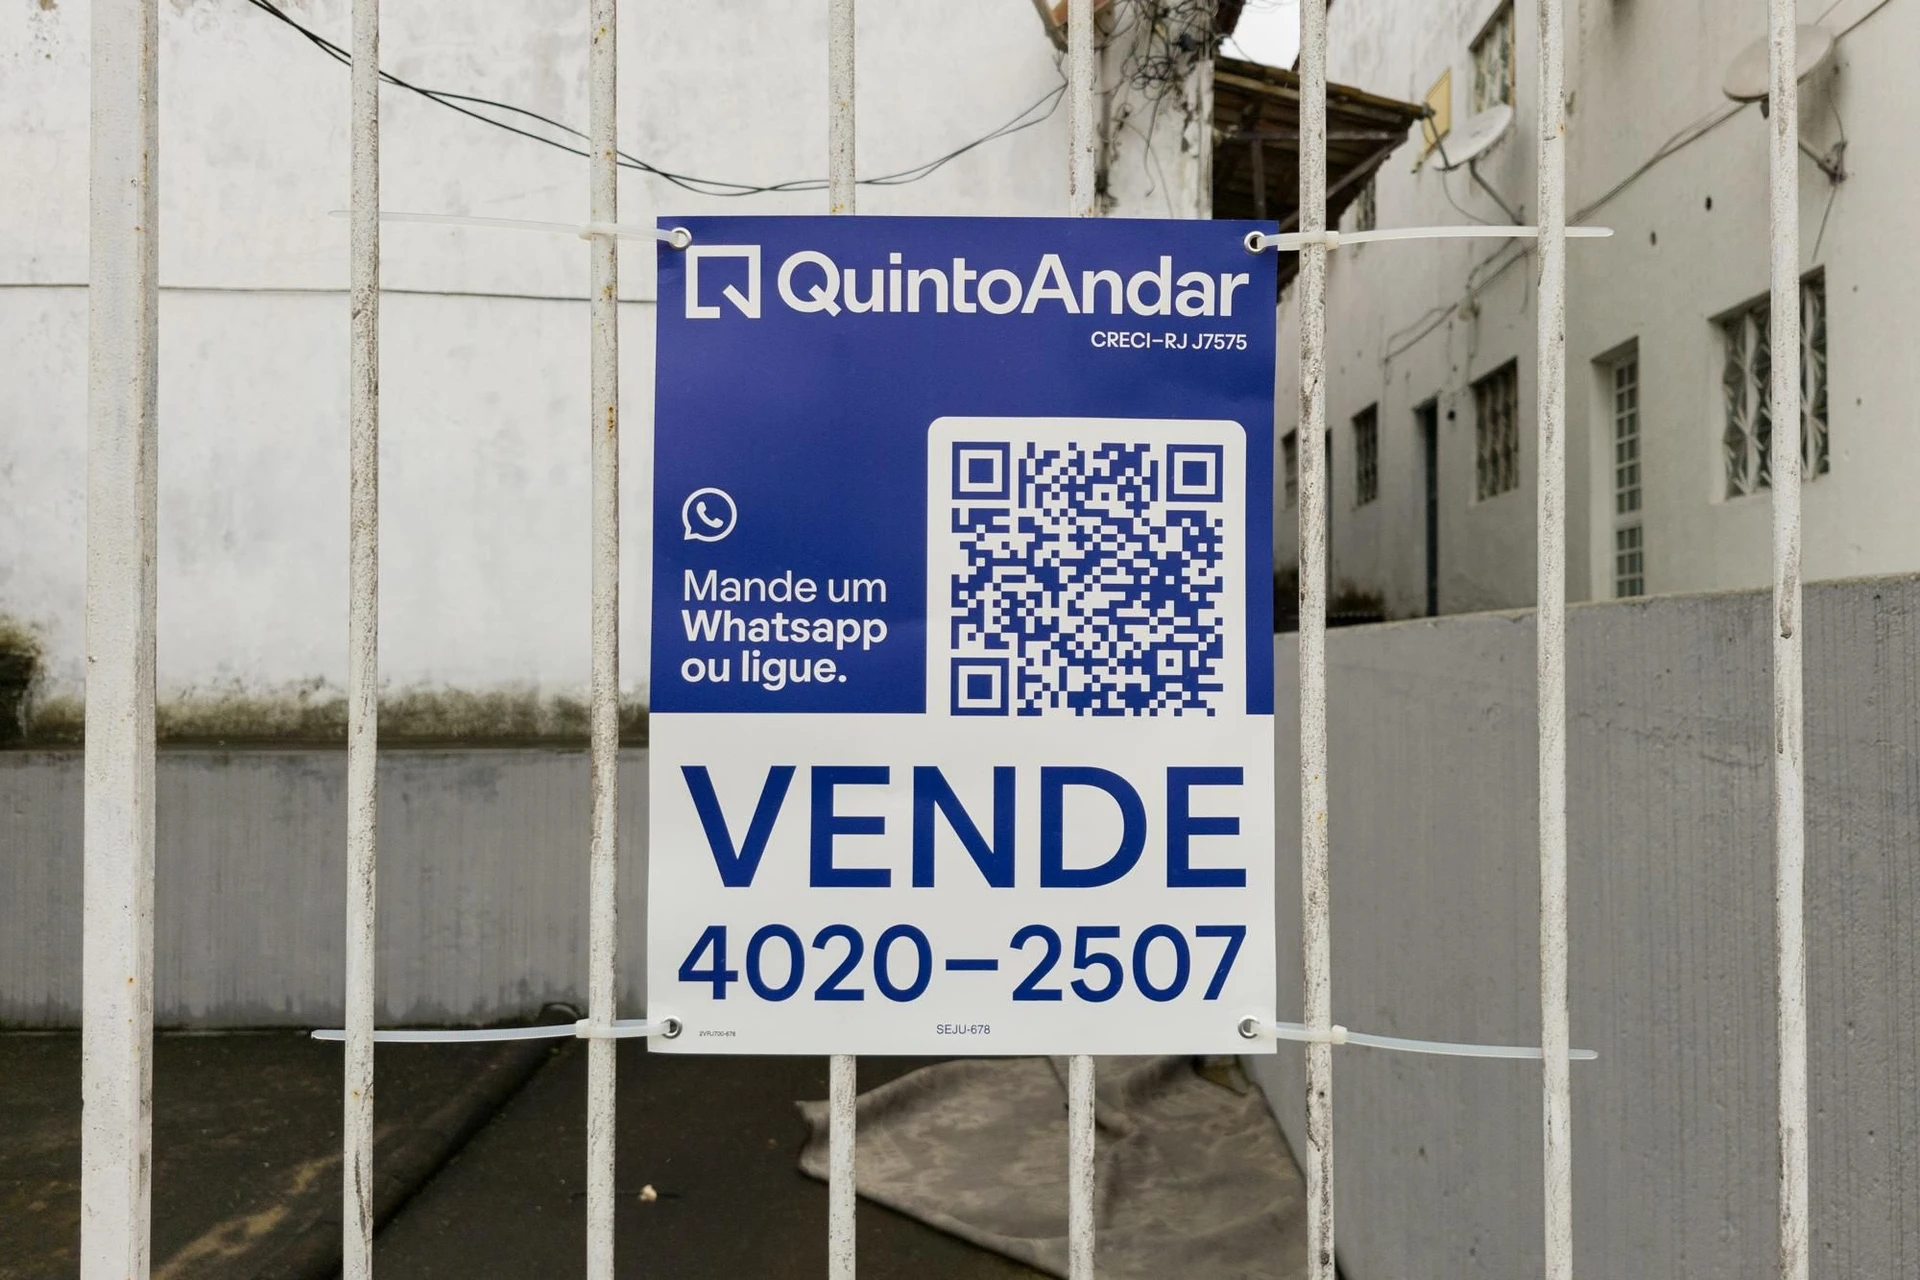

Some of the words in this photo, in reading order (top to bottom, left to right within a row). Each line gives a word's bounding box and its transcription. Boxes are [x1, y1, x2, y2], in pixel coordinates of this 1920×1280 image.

[777, 250, 1249, 317] QuintoAndar
[1090, 331, 1188, 350] CRECI-RJ
[1191, 333, 1248, 351] J7575
[684, 569, 818, 603] Mande
[828, 578, 887, 603] um
[682, 610, 888, 651] Whatsapp
[680, 656, 730, 683] ou
[741, 651, 848, 691] ligue.
[680, 765, 1247, 888] VENDE
[678, 923, 1247, 1003] 4020-2507
[936, 1023, 991, 1035] SEJU-678
